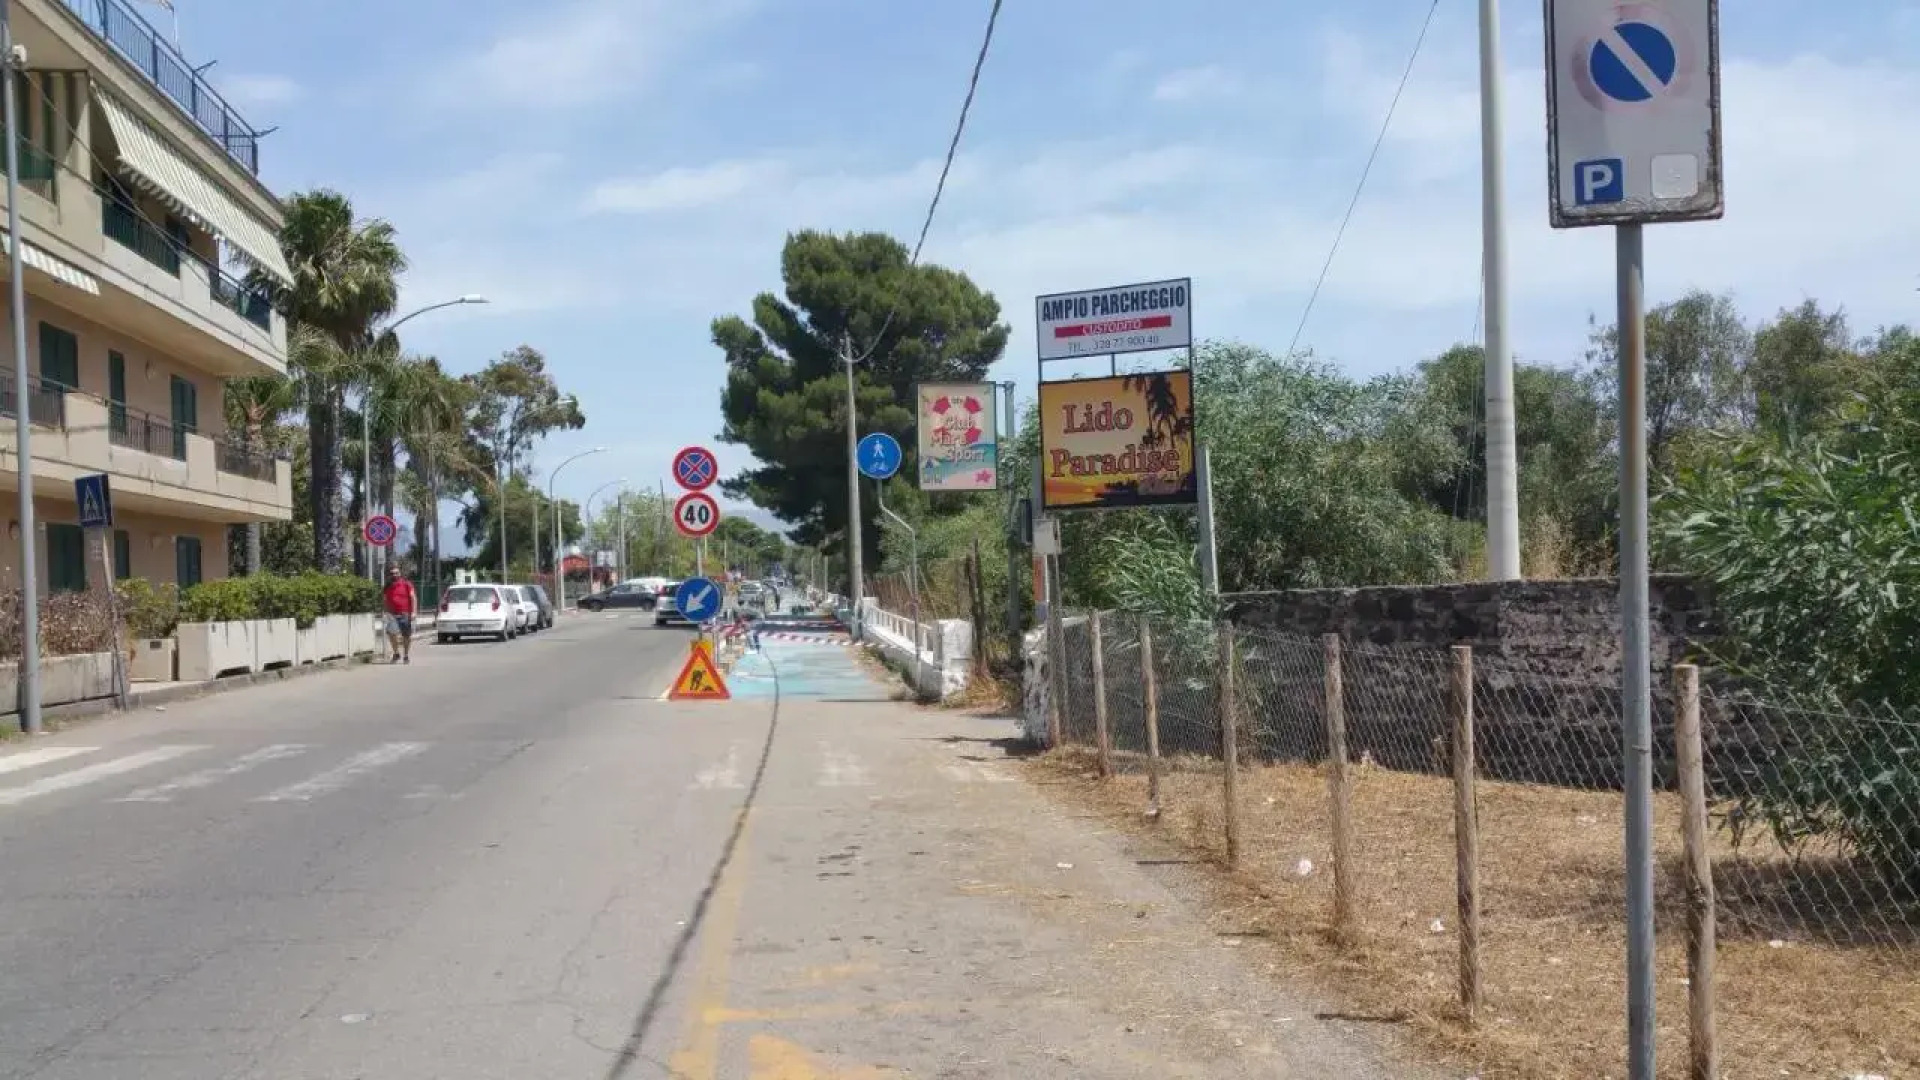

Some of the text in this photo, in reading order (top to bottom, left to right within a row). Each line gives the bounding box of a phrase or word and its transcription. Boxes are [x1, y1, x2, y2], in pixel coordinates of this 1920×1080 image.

[1584, 165, 1613, 200] P
[1042, 286, 1185, 321] AMPIO PARCHEGGIO
[1082, 320, 1142, 336] CUSTODITO
[1062, 401, 1134, 434] Lido
[1050, 443, 1180, 477] Paradise
[684, 504, 709, 525] 40
